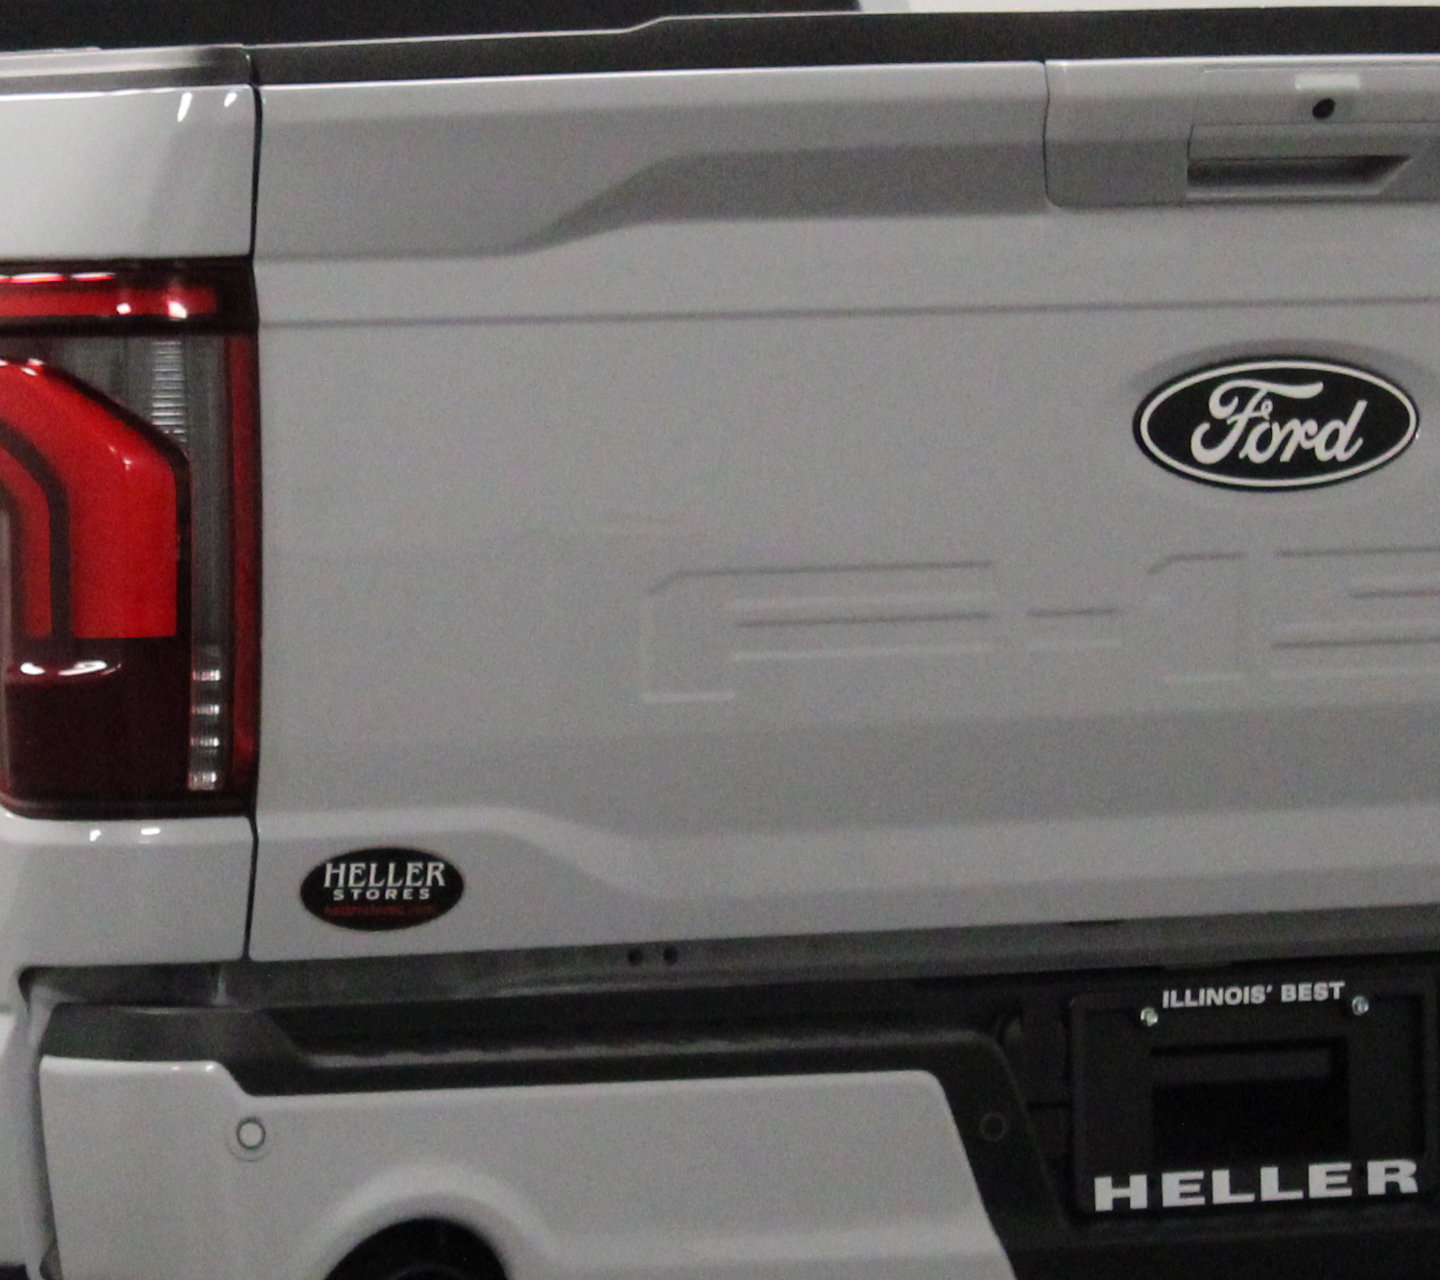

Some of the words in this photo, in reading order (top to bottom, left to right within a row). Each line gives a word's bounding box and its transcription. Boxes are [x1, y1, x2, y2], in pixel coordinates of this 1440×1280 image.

[1191, 379, 1367, 464] Ford
[323, 862, 446, 888] HELLER
[333, 888, 430, 901] STORES
[1281, 981, 1346, 1002] BEST
[1094, 1159, 1419, 1211] HELLER
